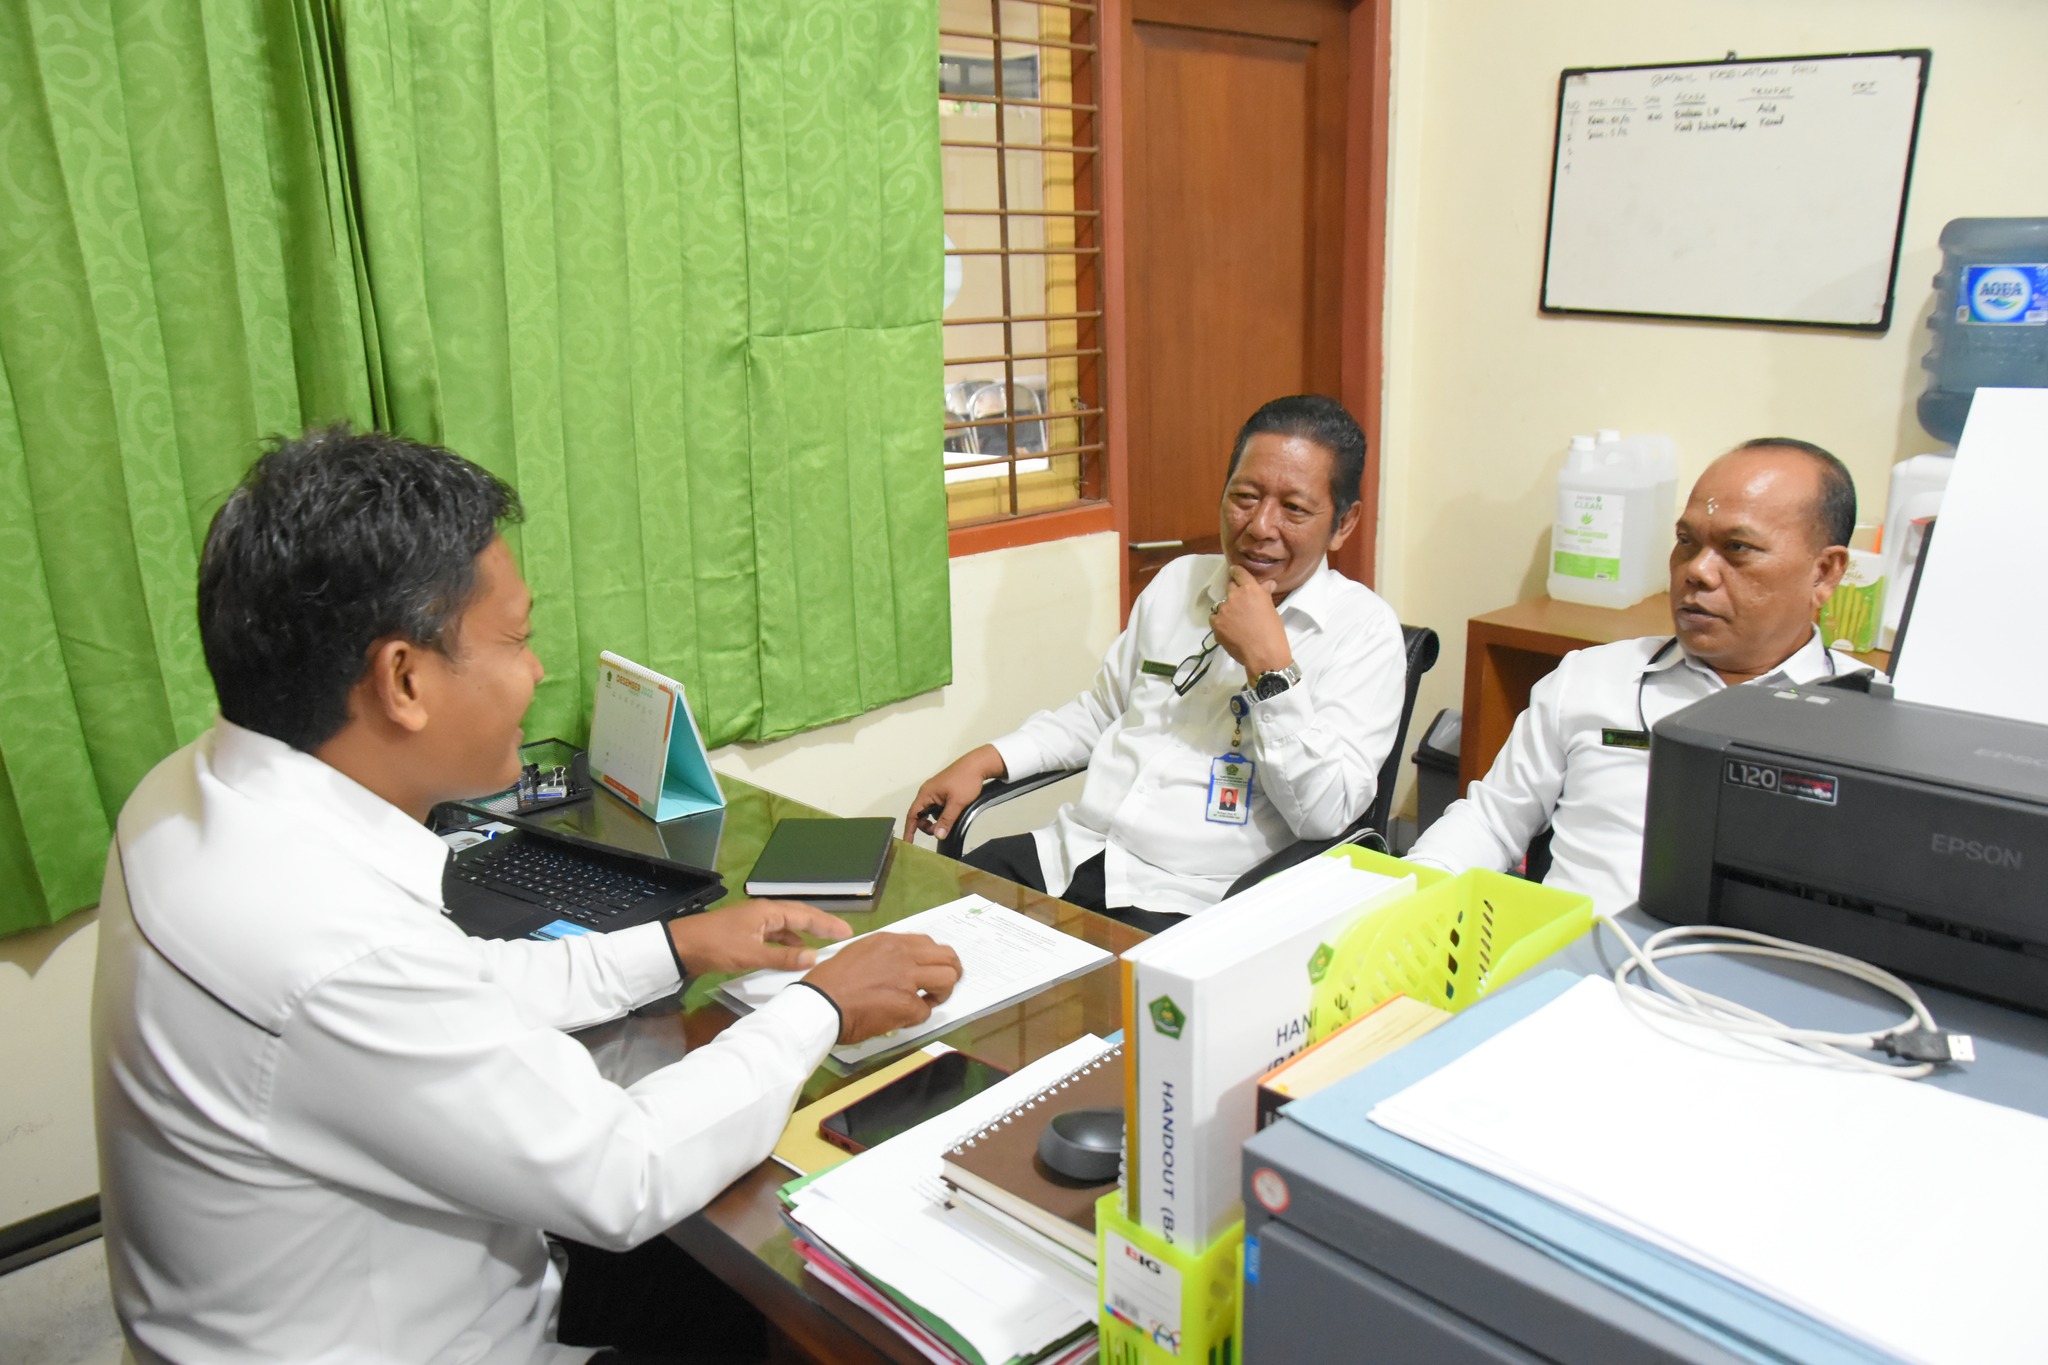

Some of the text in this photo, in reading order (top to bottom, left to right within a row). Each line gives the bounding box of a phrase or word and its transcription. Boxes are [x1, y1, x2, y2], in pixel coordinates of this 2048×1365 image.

[1979, 281, 2023, 296] AQUA
[1574, 501, 1603, 510] CLEAN
[1728, 762, 1777, 789] L120
[1931, 832, 2022, 870] EPSON
[1161, 1080, 1175, 1202] HANDOUT
[1125, 1244, 1162, 1275] BIG
